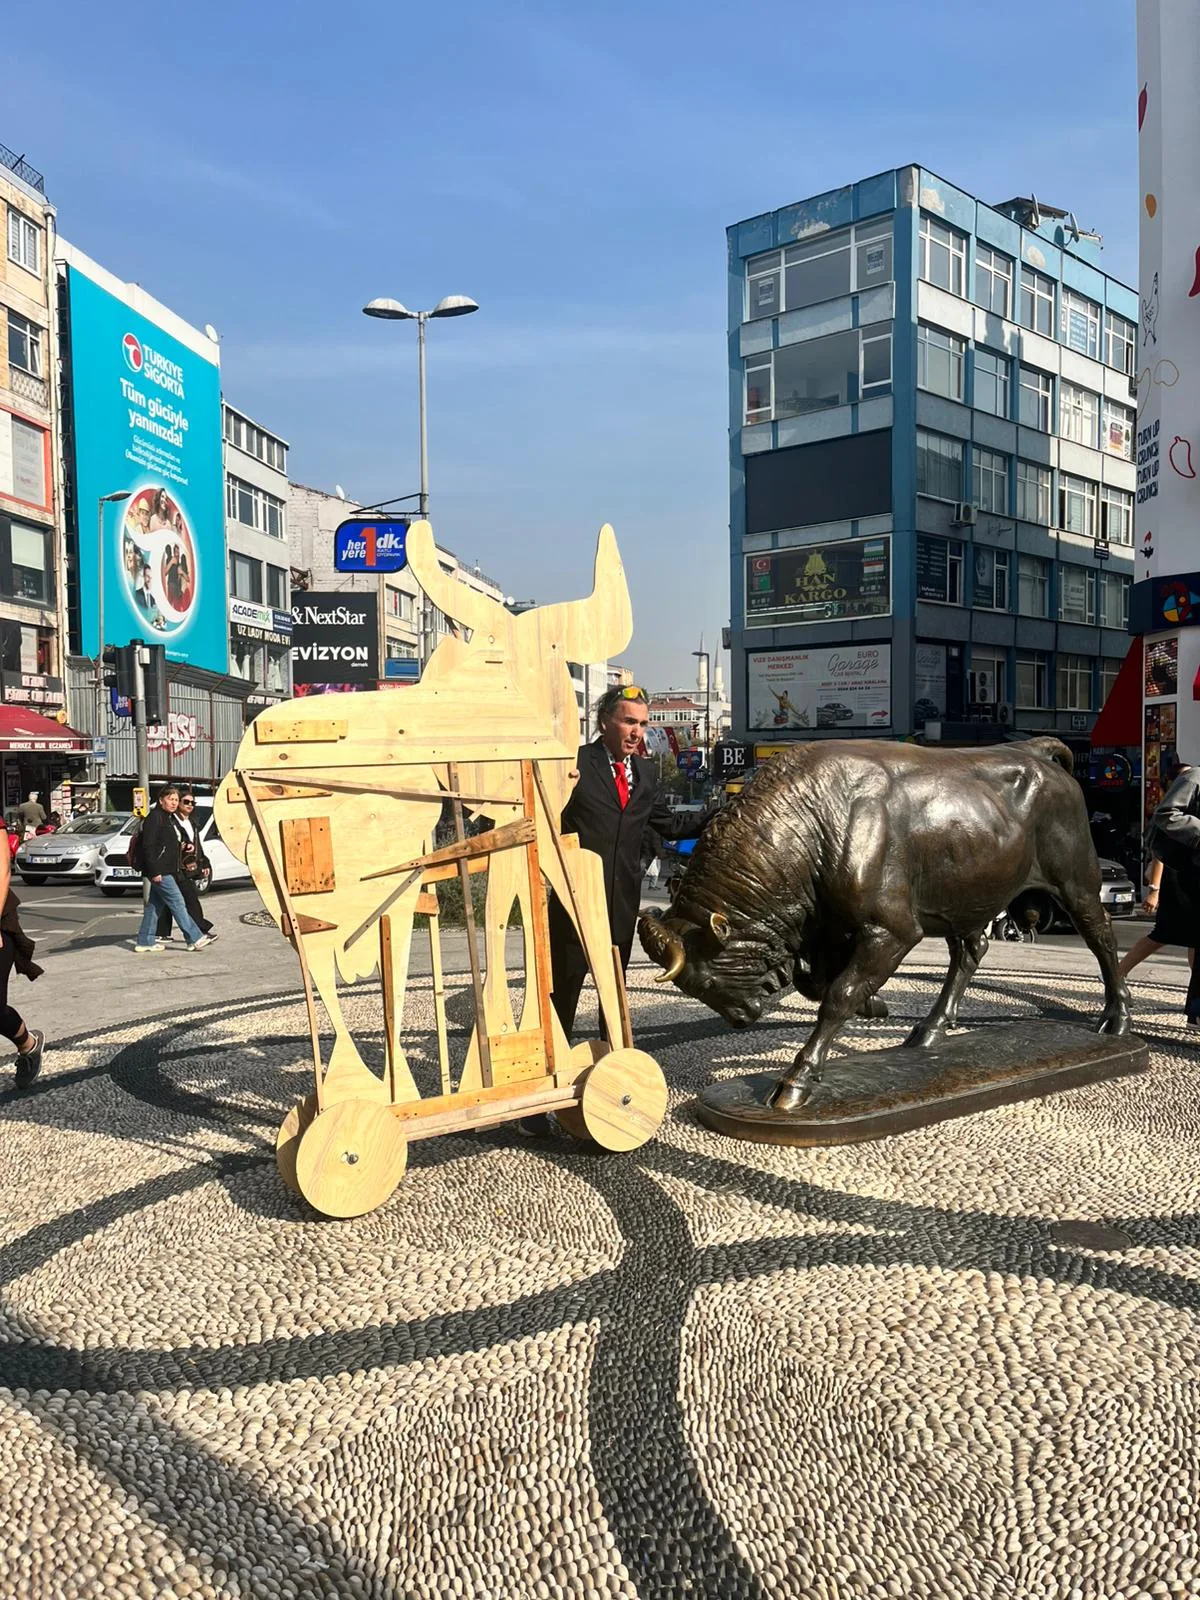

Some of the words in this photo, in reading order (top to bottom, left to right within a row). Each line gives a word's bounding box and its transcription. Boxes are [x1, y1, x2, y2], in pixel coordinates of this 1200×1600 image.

[142, 344, 184, 383] TÜRKİYE
[144, 362, 185, 400] SİGORTA
[120, 377, 146, 408] Tüm
[148, 397, 188, 431] gücüyle
[128, 408, 183, 448] yanınızda!
[1138, 423, 1151, 446] TURN
[1152, 419, 1160, 438] UP
[1137, 462, 1151, 484] TURN
[1152, 459, 1160, 478] UP
[341, 549, 366, 561] yere
[347, 540, 366, 550] her
[359, 527, 377, 566] 1
[795, 574, 836, 587] HAN
[784, 588, 847, 604] KARGO
[291, 606, 305, 625] &
[305, 606, 367, 625] NextStar
[827, 653, 880, 677] Garage
[857, 650, 879, 659] EURO
[722, 748, 745, 766] BE
